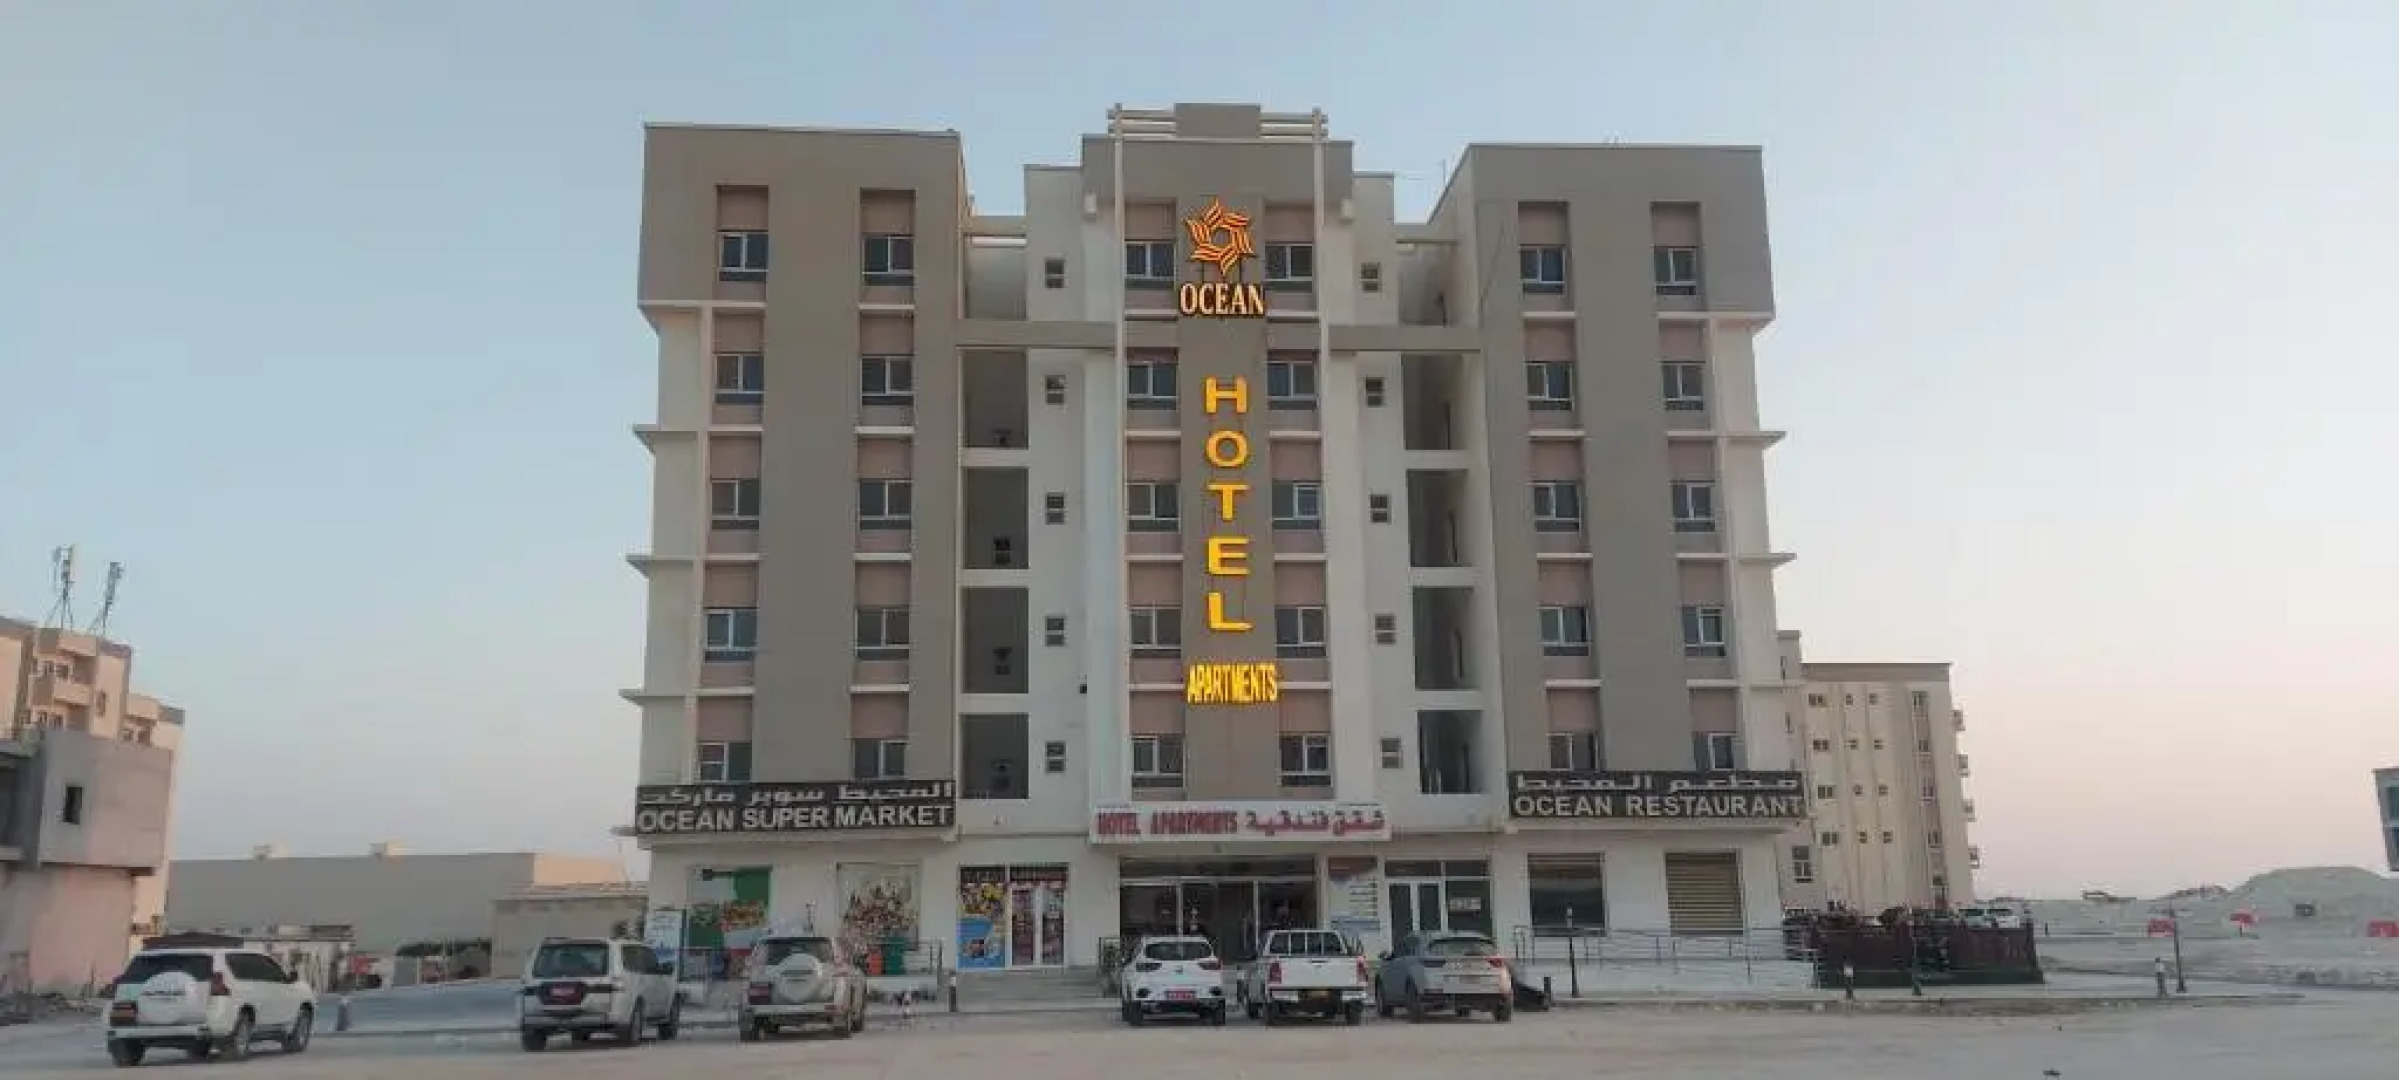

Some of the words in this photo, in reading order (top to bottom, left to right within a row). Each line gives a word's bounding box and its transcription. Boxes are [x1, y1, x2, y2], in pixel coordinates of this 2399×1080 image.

[1180, 282, 1264, 315] OCEAN
[1205, 376, 1252, 631] HOTEL
[1187, 662, 1277, 704] APARTMENTS
[640, 787, 736, 807] ماركت
[1668, 775, 1798, 792] مطعم
[751, 789, 825, 806] سوبر
[1514, 796, 1612, 816] OCEAN
[1626, 795, 1803, 816] RESTAURANT
[638, 809, 734, 831] OCEAN
[742, 806, 830, 829] SUPER
[834, 804, 952, 827] MARKET
[1098, 811, 1141, 835] HOTEL
[1151, 811, 1238, 834] APARTMENTS
[1246, 809, 1329, 836] فندقية
[1332, 809, 1385, 836] شقق
